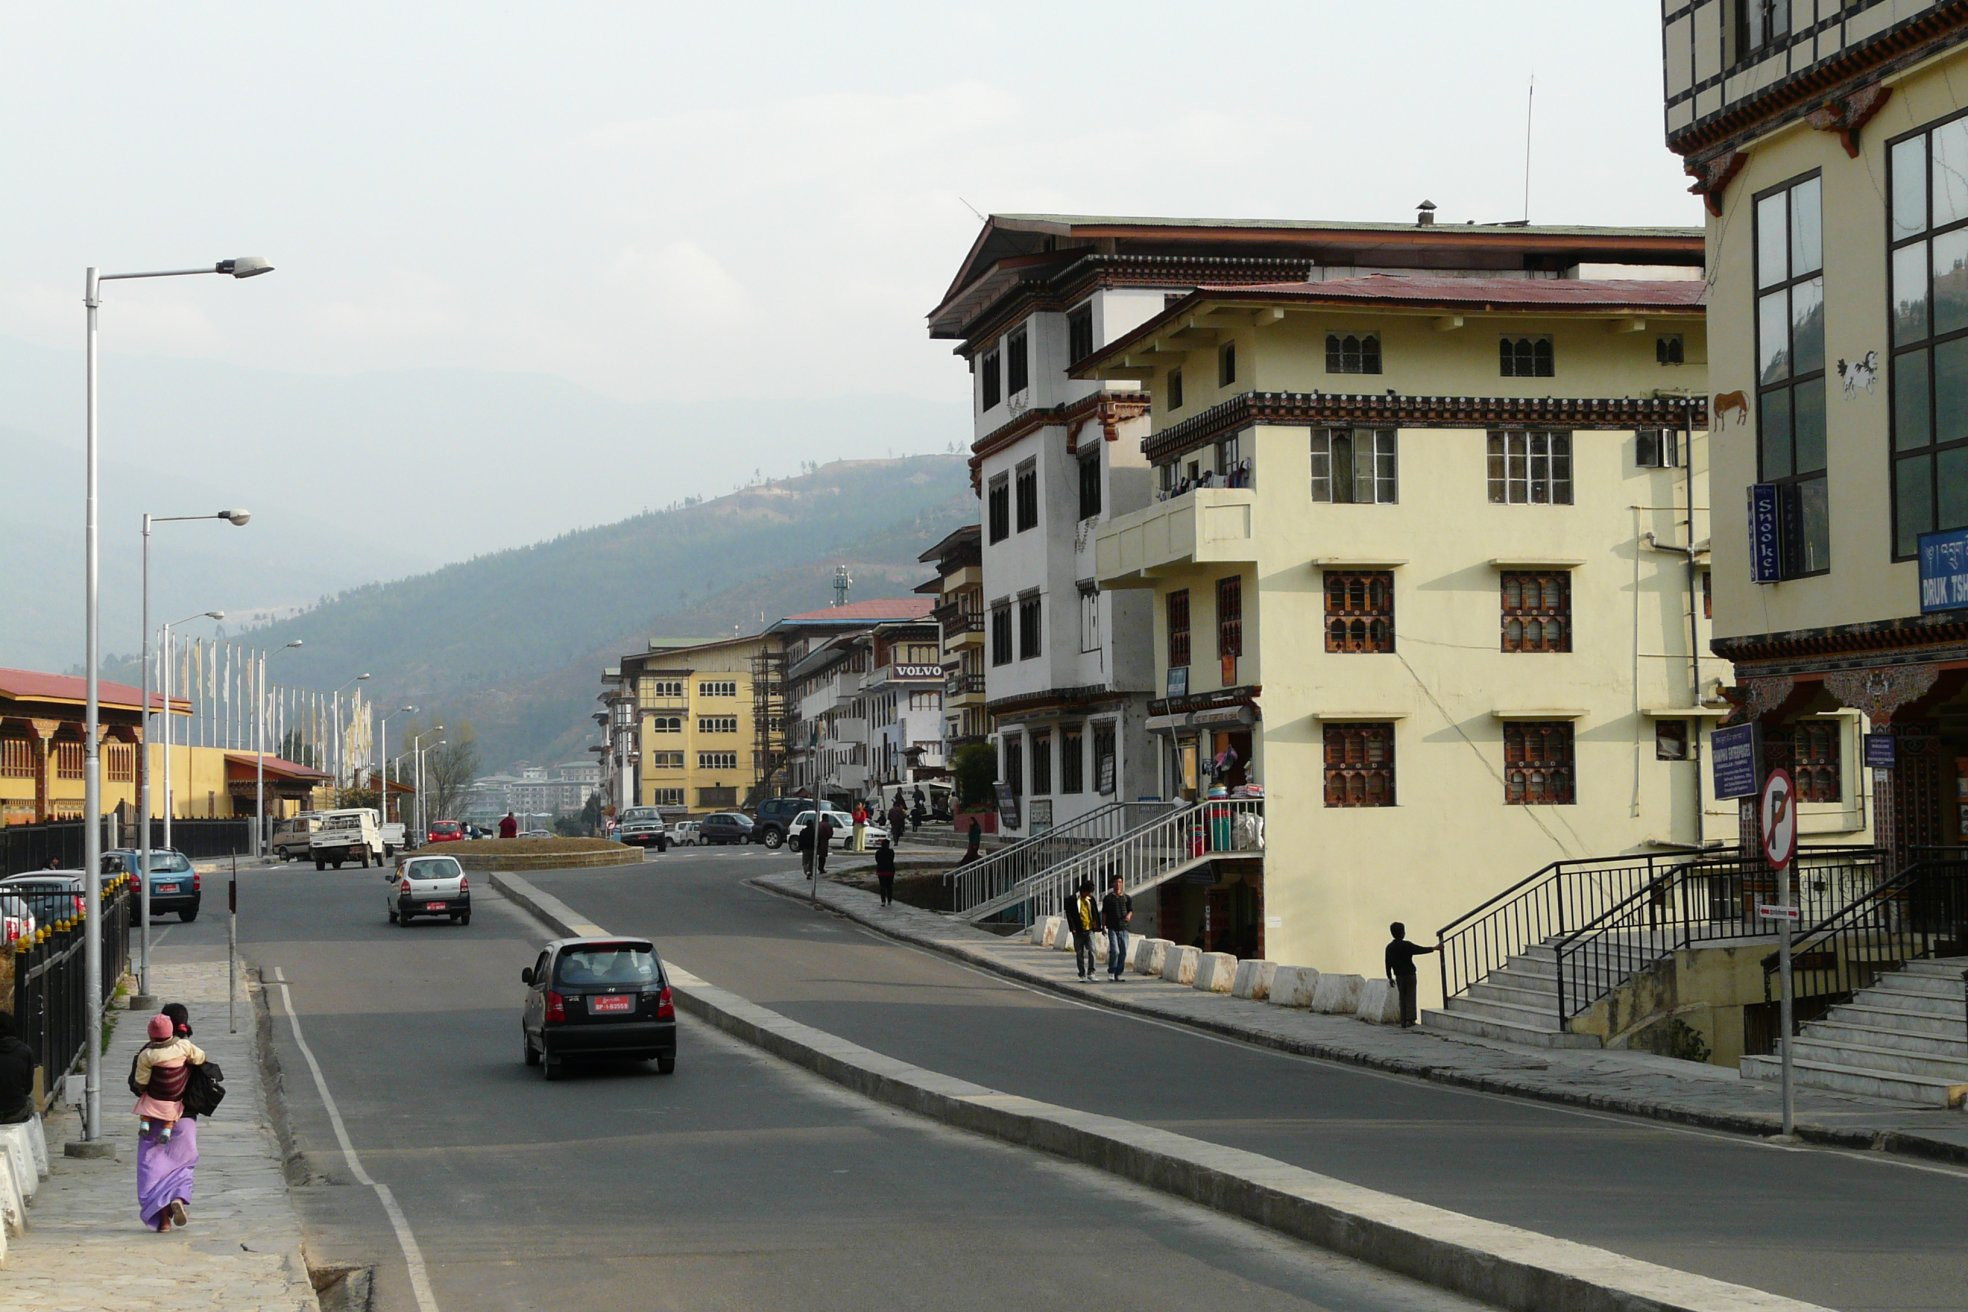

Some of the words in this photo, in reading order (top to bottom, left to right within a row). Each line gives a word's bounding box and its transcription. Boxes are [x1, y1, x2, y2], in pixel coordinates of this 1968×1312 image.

[1759, 499, 1774, 577] Snooker
[1923, 577, 1948, 607] DRUK
[896, 666, 942, 676] VOLVO
